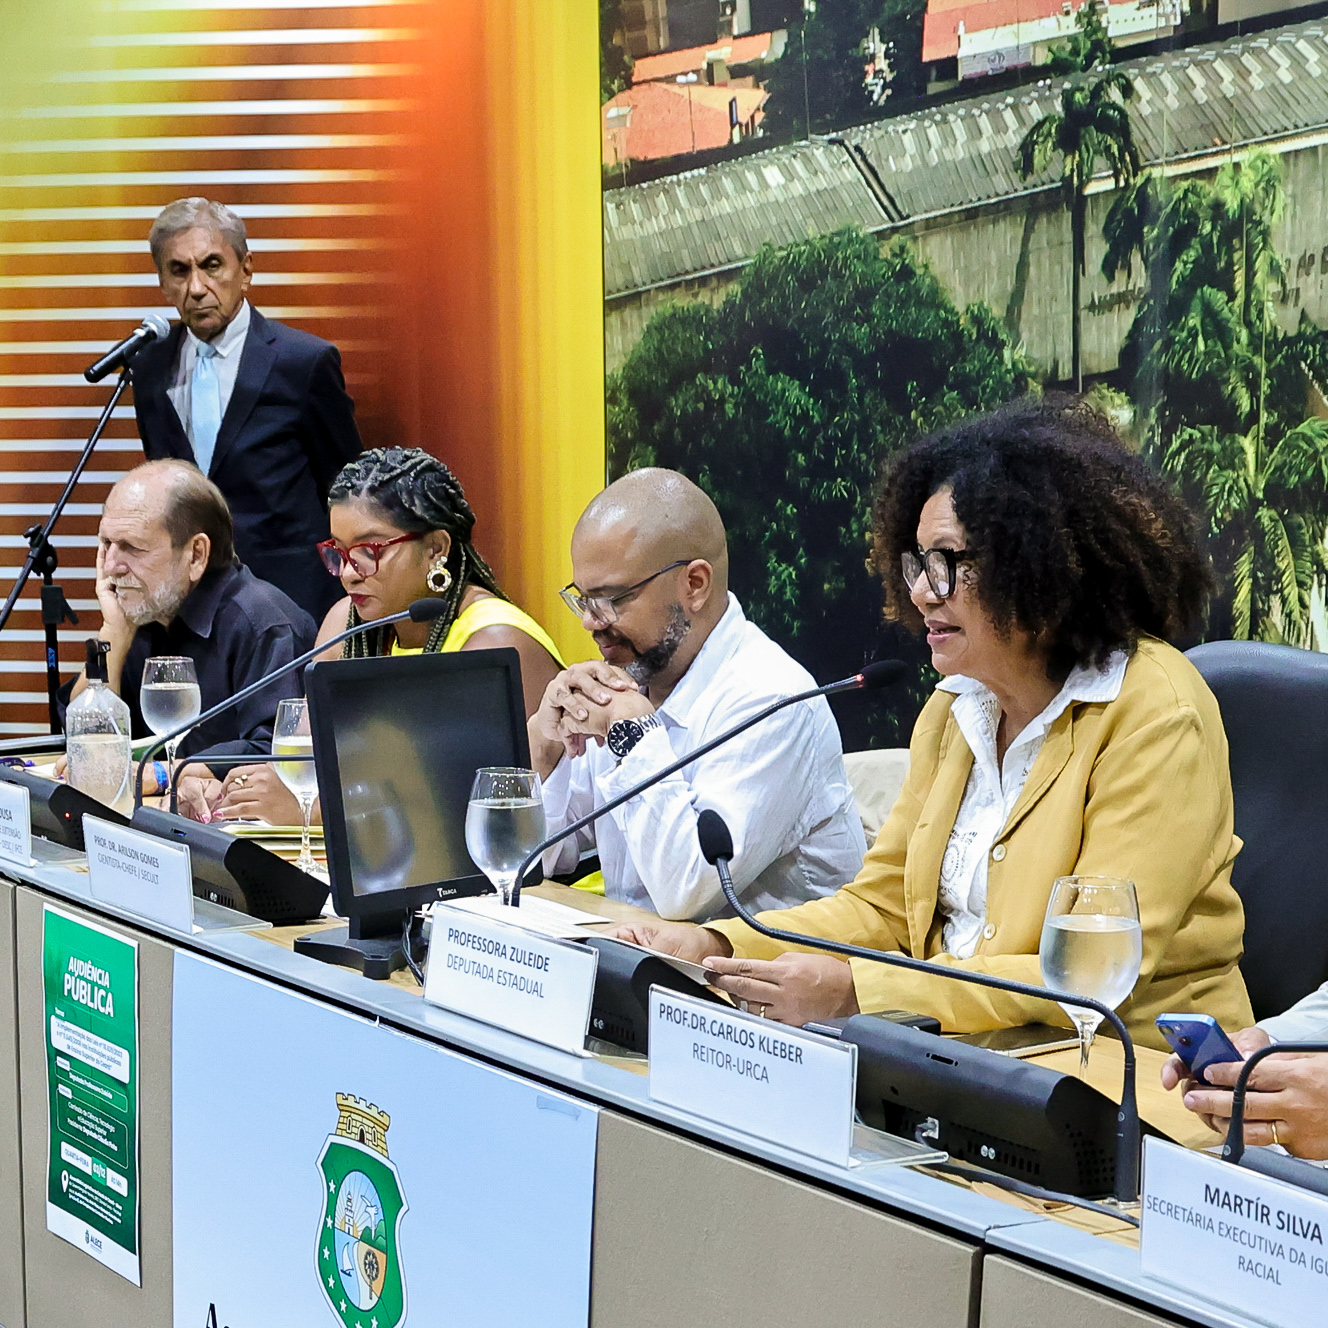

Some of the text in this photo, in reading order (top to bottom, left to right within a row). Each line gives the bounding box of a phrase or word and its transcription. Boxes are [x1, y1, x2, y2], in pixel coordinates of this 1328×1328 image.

[118, 845, 139, 861] ARILSON
[140, 852, 159, 868] GOMES
[68, 956, 110, 988] AUDIÊNCIA
[447, 927, 550, 973] PROFESSORA ZULEIDE
[447, 954, 545, 999] DEPUTADA ESTADUAL
[659, 1002, 804, 1065] PROF.DR.CARLOS KLEBER
[692, 1042, 770, 1084] REITOR-URCA
[1146, 1194, 1215, 1235] SECRETÁRIA
[1219, 1221, 1285, 1260] EXECUTIVA
[1289, 1247, 1307, 1267] DA
[1204, 1183, 1324, 1246] MARTÍR SILVA
[1238, 1255, 1282, 1286] RACIAL
